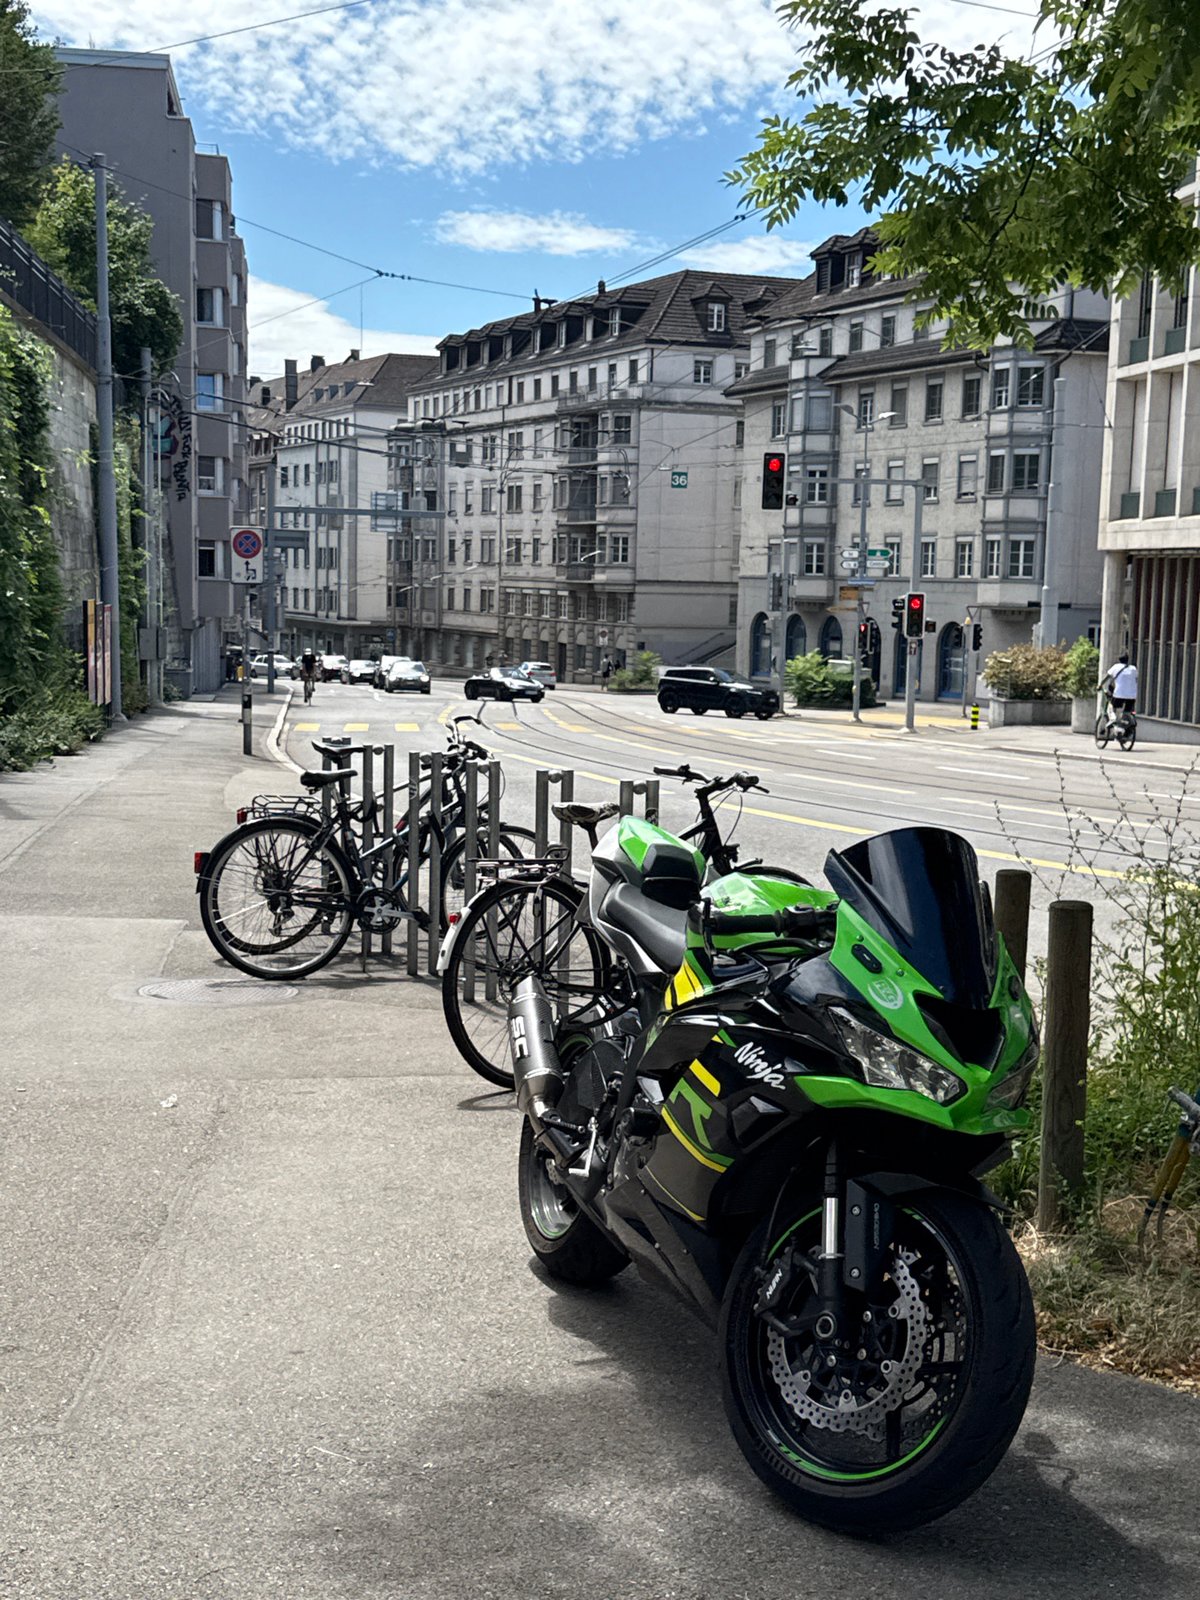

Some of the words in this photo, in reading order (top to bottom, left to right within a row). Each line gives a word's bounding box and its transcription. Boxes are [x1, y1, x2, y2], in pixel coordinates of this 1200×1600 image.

[671, 475, 687, 486] 36
[510, 1015, 529, 1059] SC
[733, 1041, 786, 1091] Ninja
